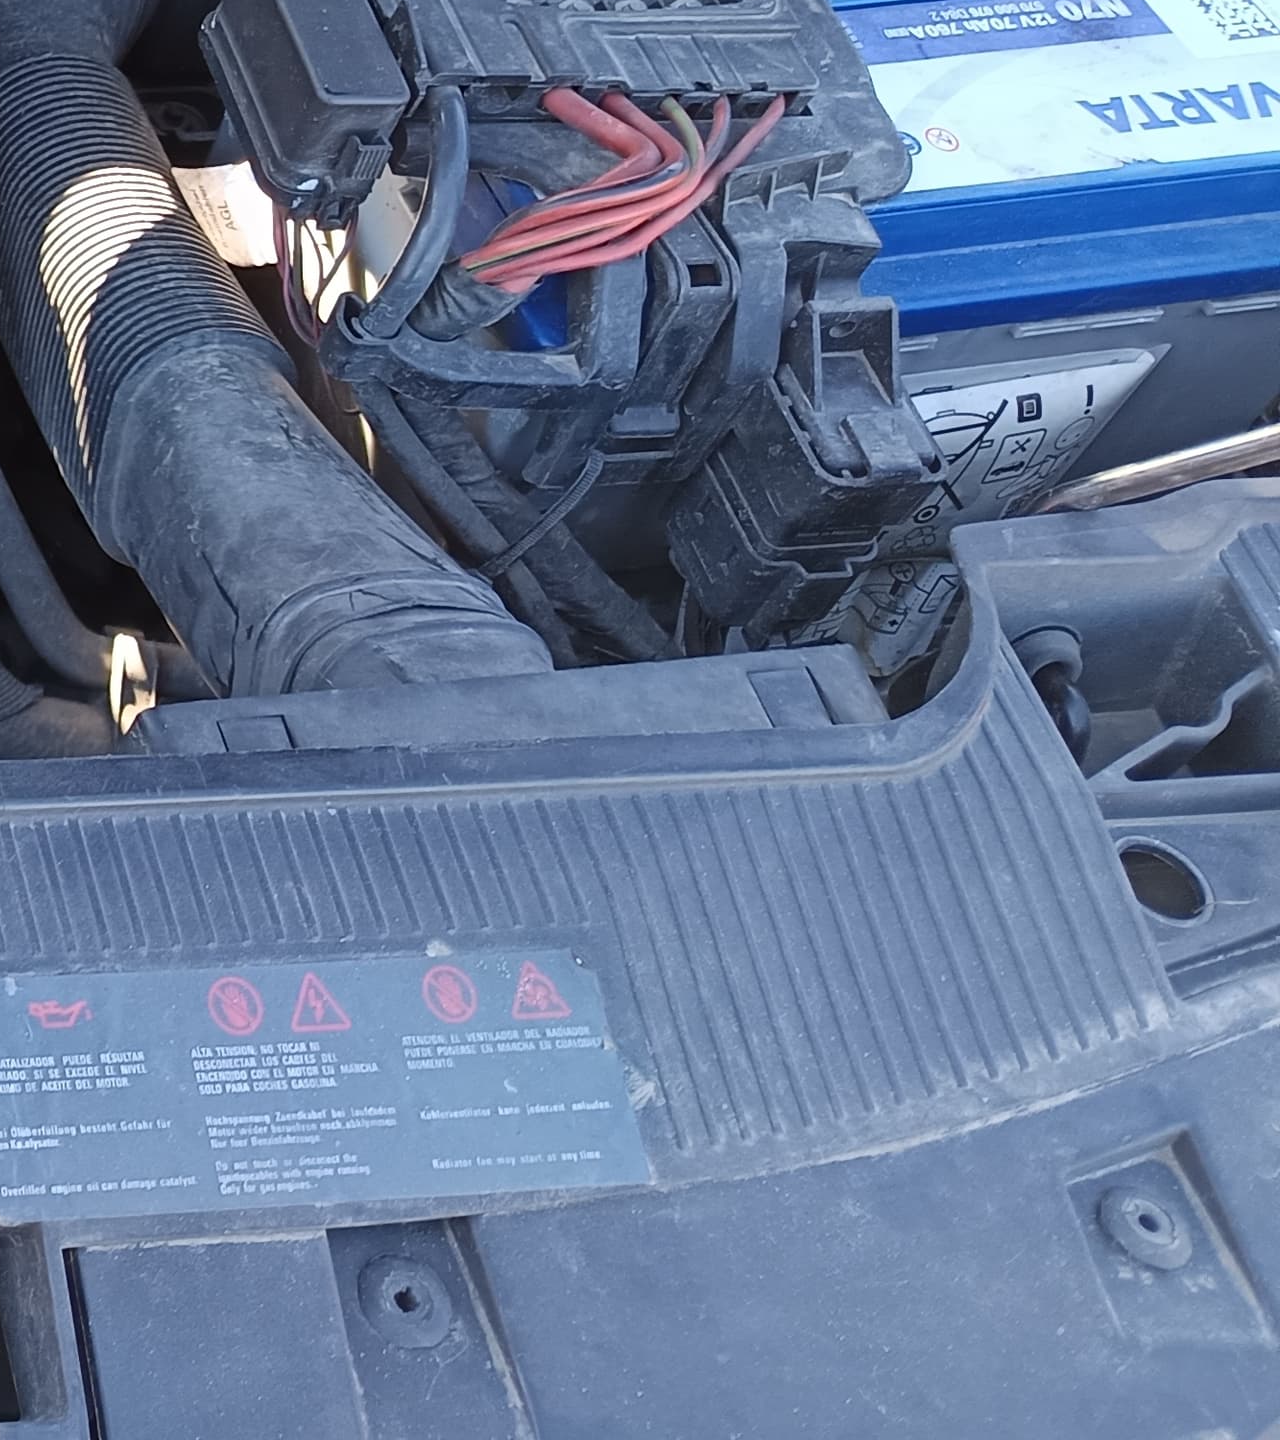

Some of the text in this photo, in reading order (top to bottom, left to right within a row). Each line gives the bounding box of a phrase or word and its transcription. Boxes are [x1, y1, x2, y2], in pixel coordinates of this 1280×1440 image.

[963, 15, 1017, 31] 70Ah
[1020, 13, 1057, 28] 12V
[1075, 82, 1280, 133] VARTA
[260, 1043, 274, 1055] NO
[276, 1042, 307, 1054] TOCAR
[62, 1054, 92, 1066] PUEDE
[261, 1056, 279, 1067] LOS
[33, 1070, 44, 1081] SI
[48, 1068, 60, 1079] SE
[65, 1066, 100, 1078] EXCEDE
[105, 1064, 117, 1075] EL
[120, 1063, 148, 1075] NIVEL
[250, 1068, 270, 1080] CON
[273, 1067, 285, 1078] EL
[25, 1082, 37, 1093] DE
[41, 1080, 72, 1092] ACEITE
[75, 1079, 92, 1090] DEL
[198, 1083, 223, 1095] SOLO
[225, 1081, 250, 1094] PARA
[253, 1079, 288, 1092] COCHES
[101, 1182, 119, 1192] can
